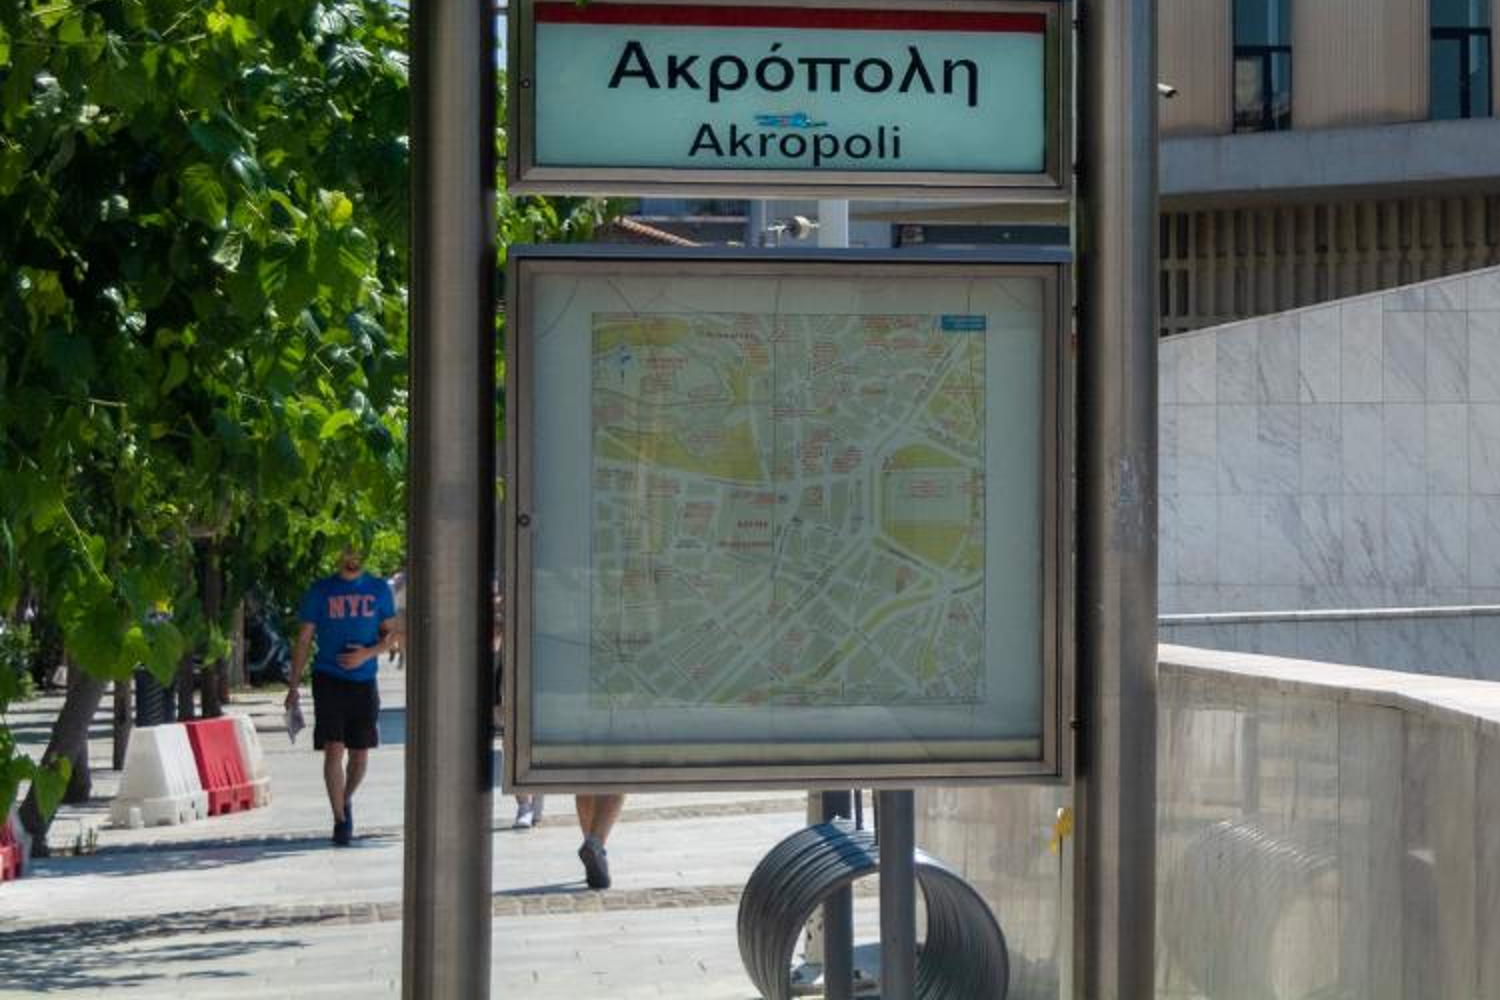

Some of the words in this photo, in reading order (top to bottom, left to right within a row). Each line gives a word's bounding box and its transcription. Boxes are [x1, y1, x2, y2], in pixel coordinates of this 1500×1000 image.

[607, 40, 979, 108] Ακρόπολη
[687, 123, 902, 168] Akropoli
[328, 595, 376, 618] NYC
